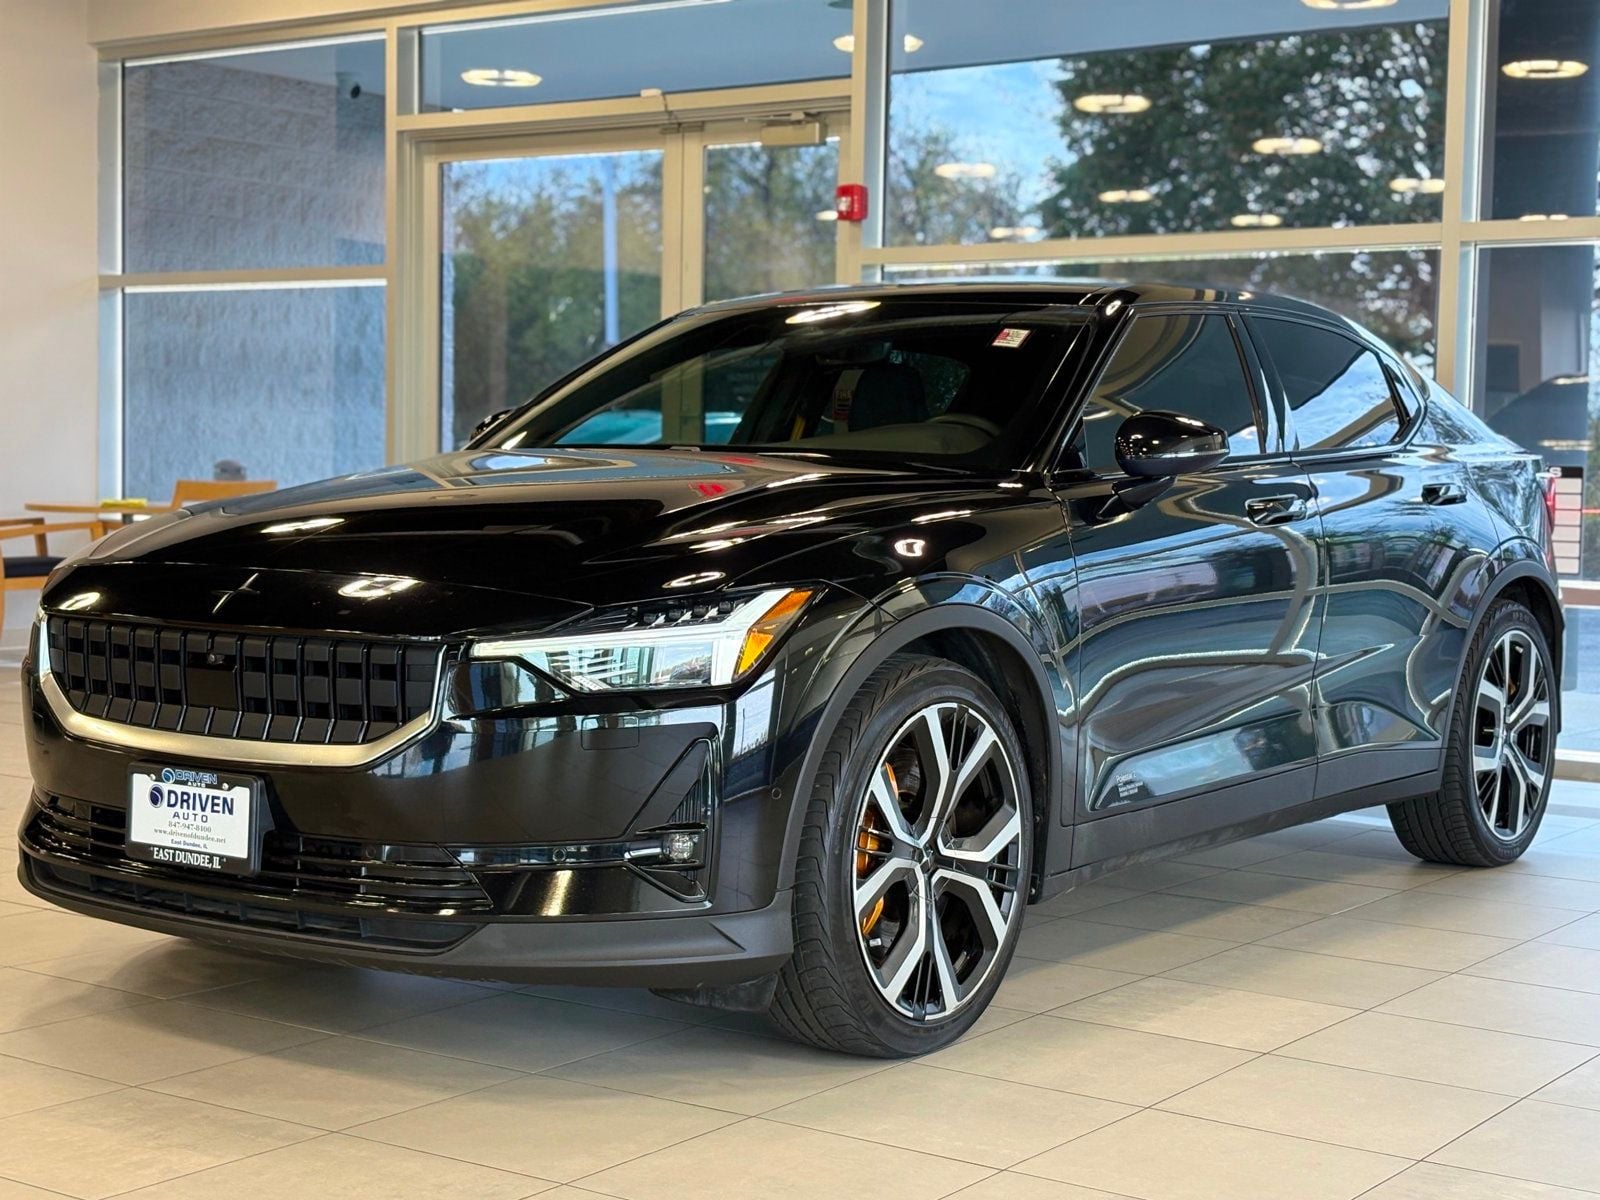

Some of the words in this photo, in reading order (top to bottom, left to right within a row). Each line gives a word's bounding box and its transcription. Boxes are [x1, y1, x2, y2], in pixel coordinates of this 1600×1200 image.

[175, 770, 217, 784] DRIVEN
[167, 790, 234, 815] DRIVEN
[172, 811, 209, 823] AUTO
[153, 847, 175, 862] EAST
[175, 850, 212, 869] DUNDEE,
[213, 856, 221, 869] IL
